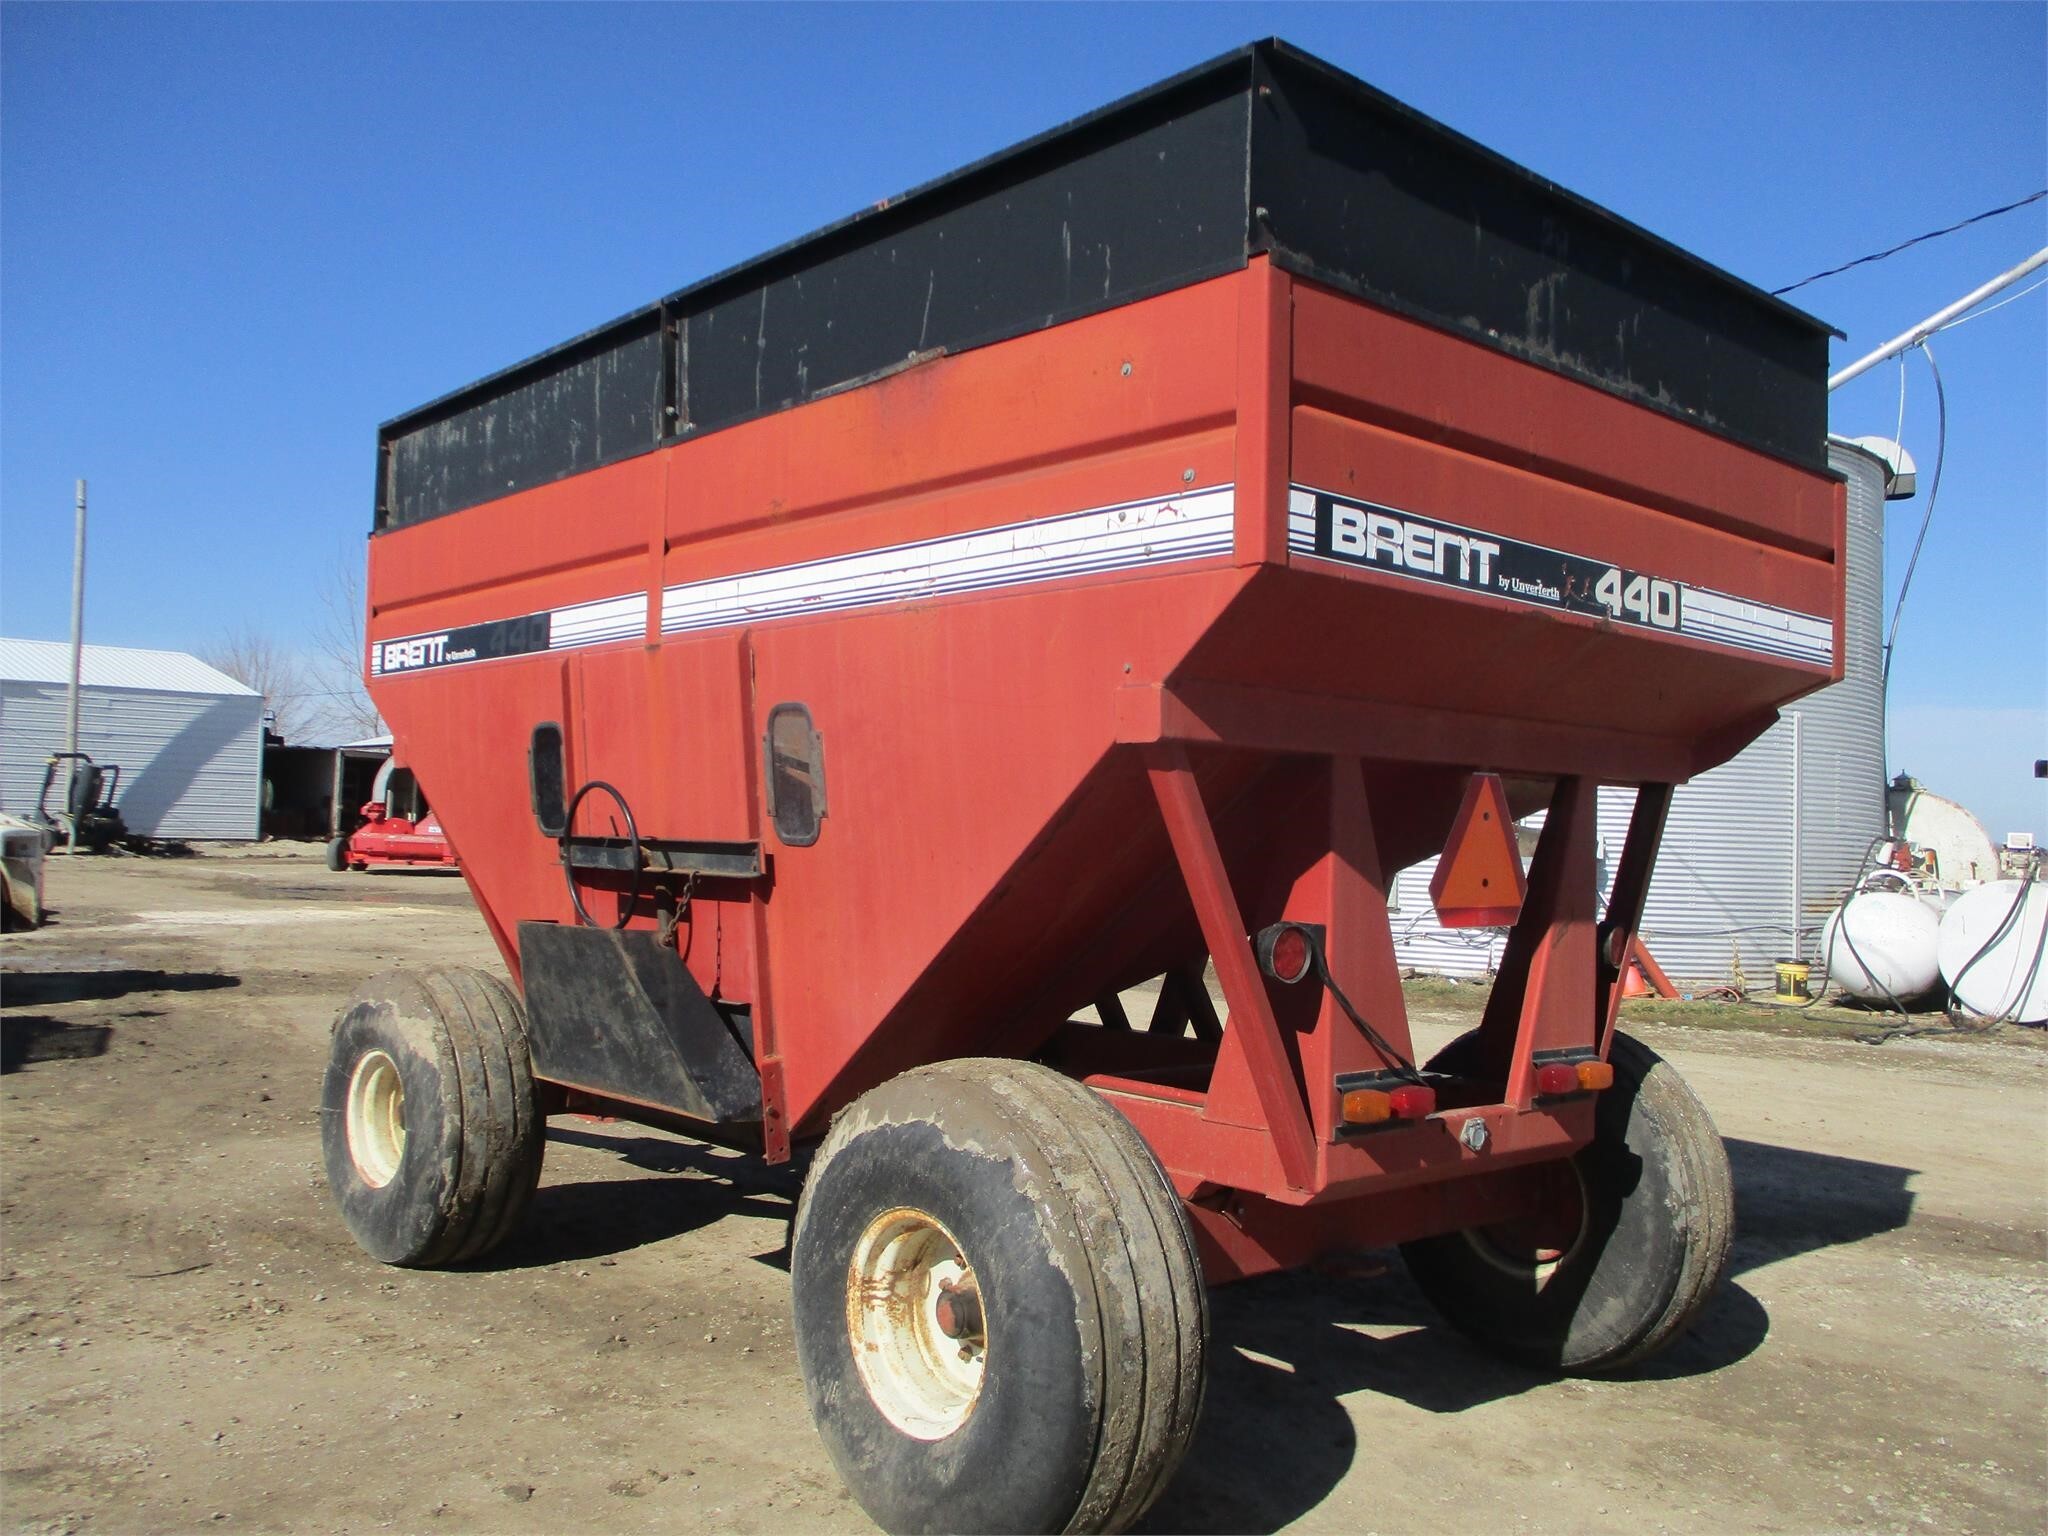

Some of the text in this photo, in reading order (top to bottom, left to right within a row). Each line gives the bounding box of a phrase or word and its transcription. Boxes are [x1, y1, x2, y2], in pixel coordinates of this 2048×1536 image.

[1332, 503, 1676, 629] BRENT by Unverferth 440
[384, 634, 448, 670] BRENT
